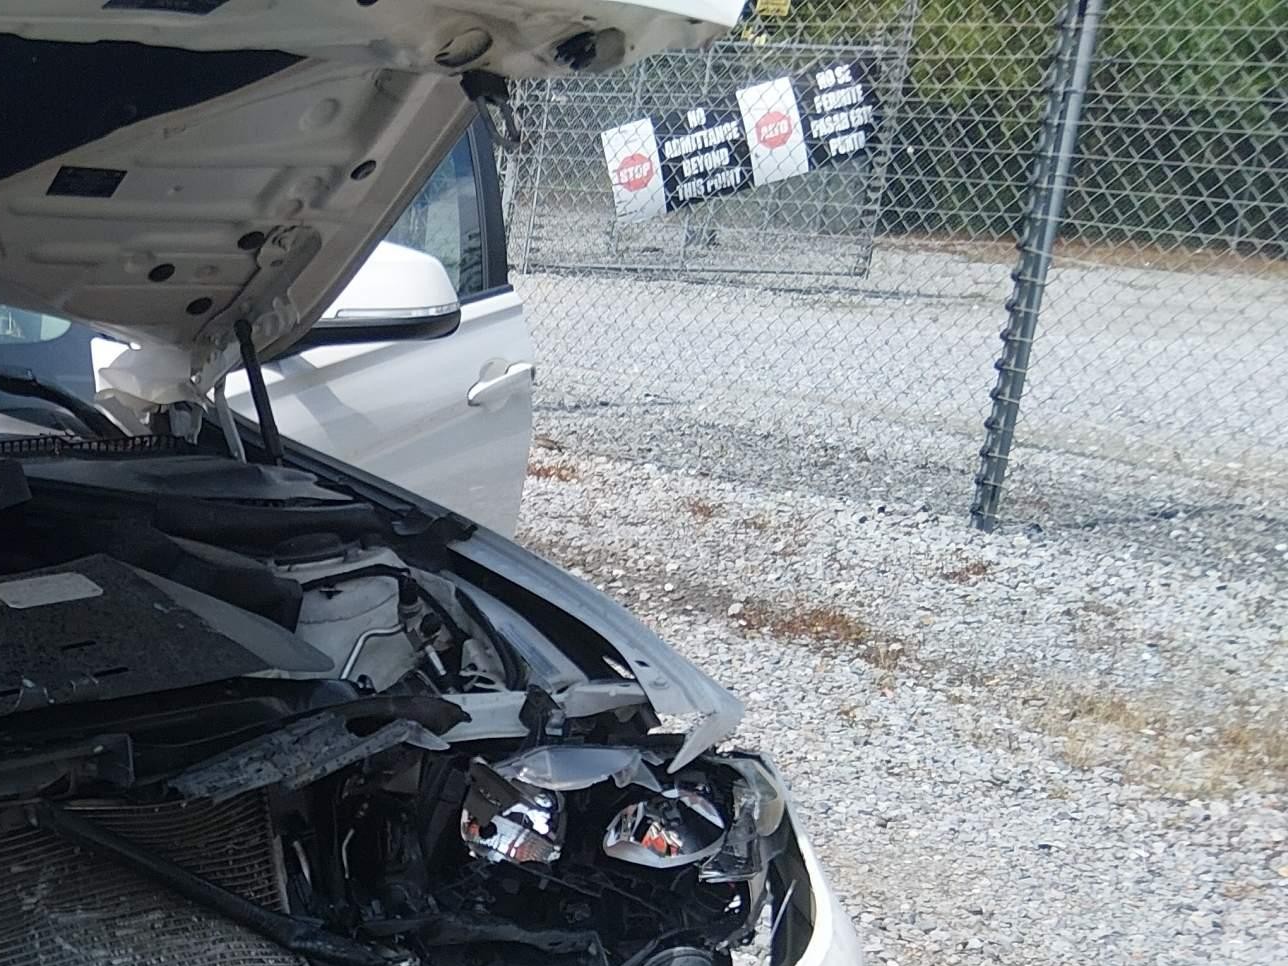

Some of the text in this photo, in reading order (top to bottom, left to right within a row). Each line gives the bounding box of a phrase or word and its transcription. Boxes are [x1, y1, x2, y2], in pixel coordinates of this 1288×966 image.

[687, 108, 706, 128] NO
[664, 121, 740, 159] ADMITTANCE
[619, 162, 651, 183] STOP
[682, 148, 730, 177] BEYOND
[676, 167, 742, 201] THIS POINT
